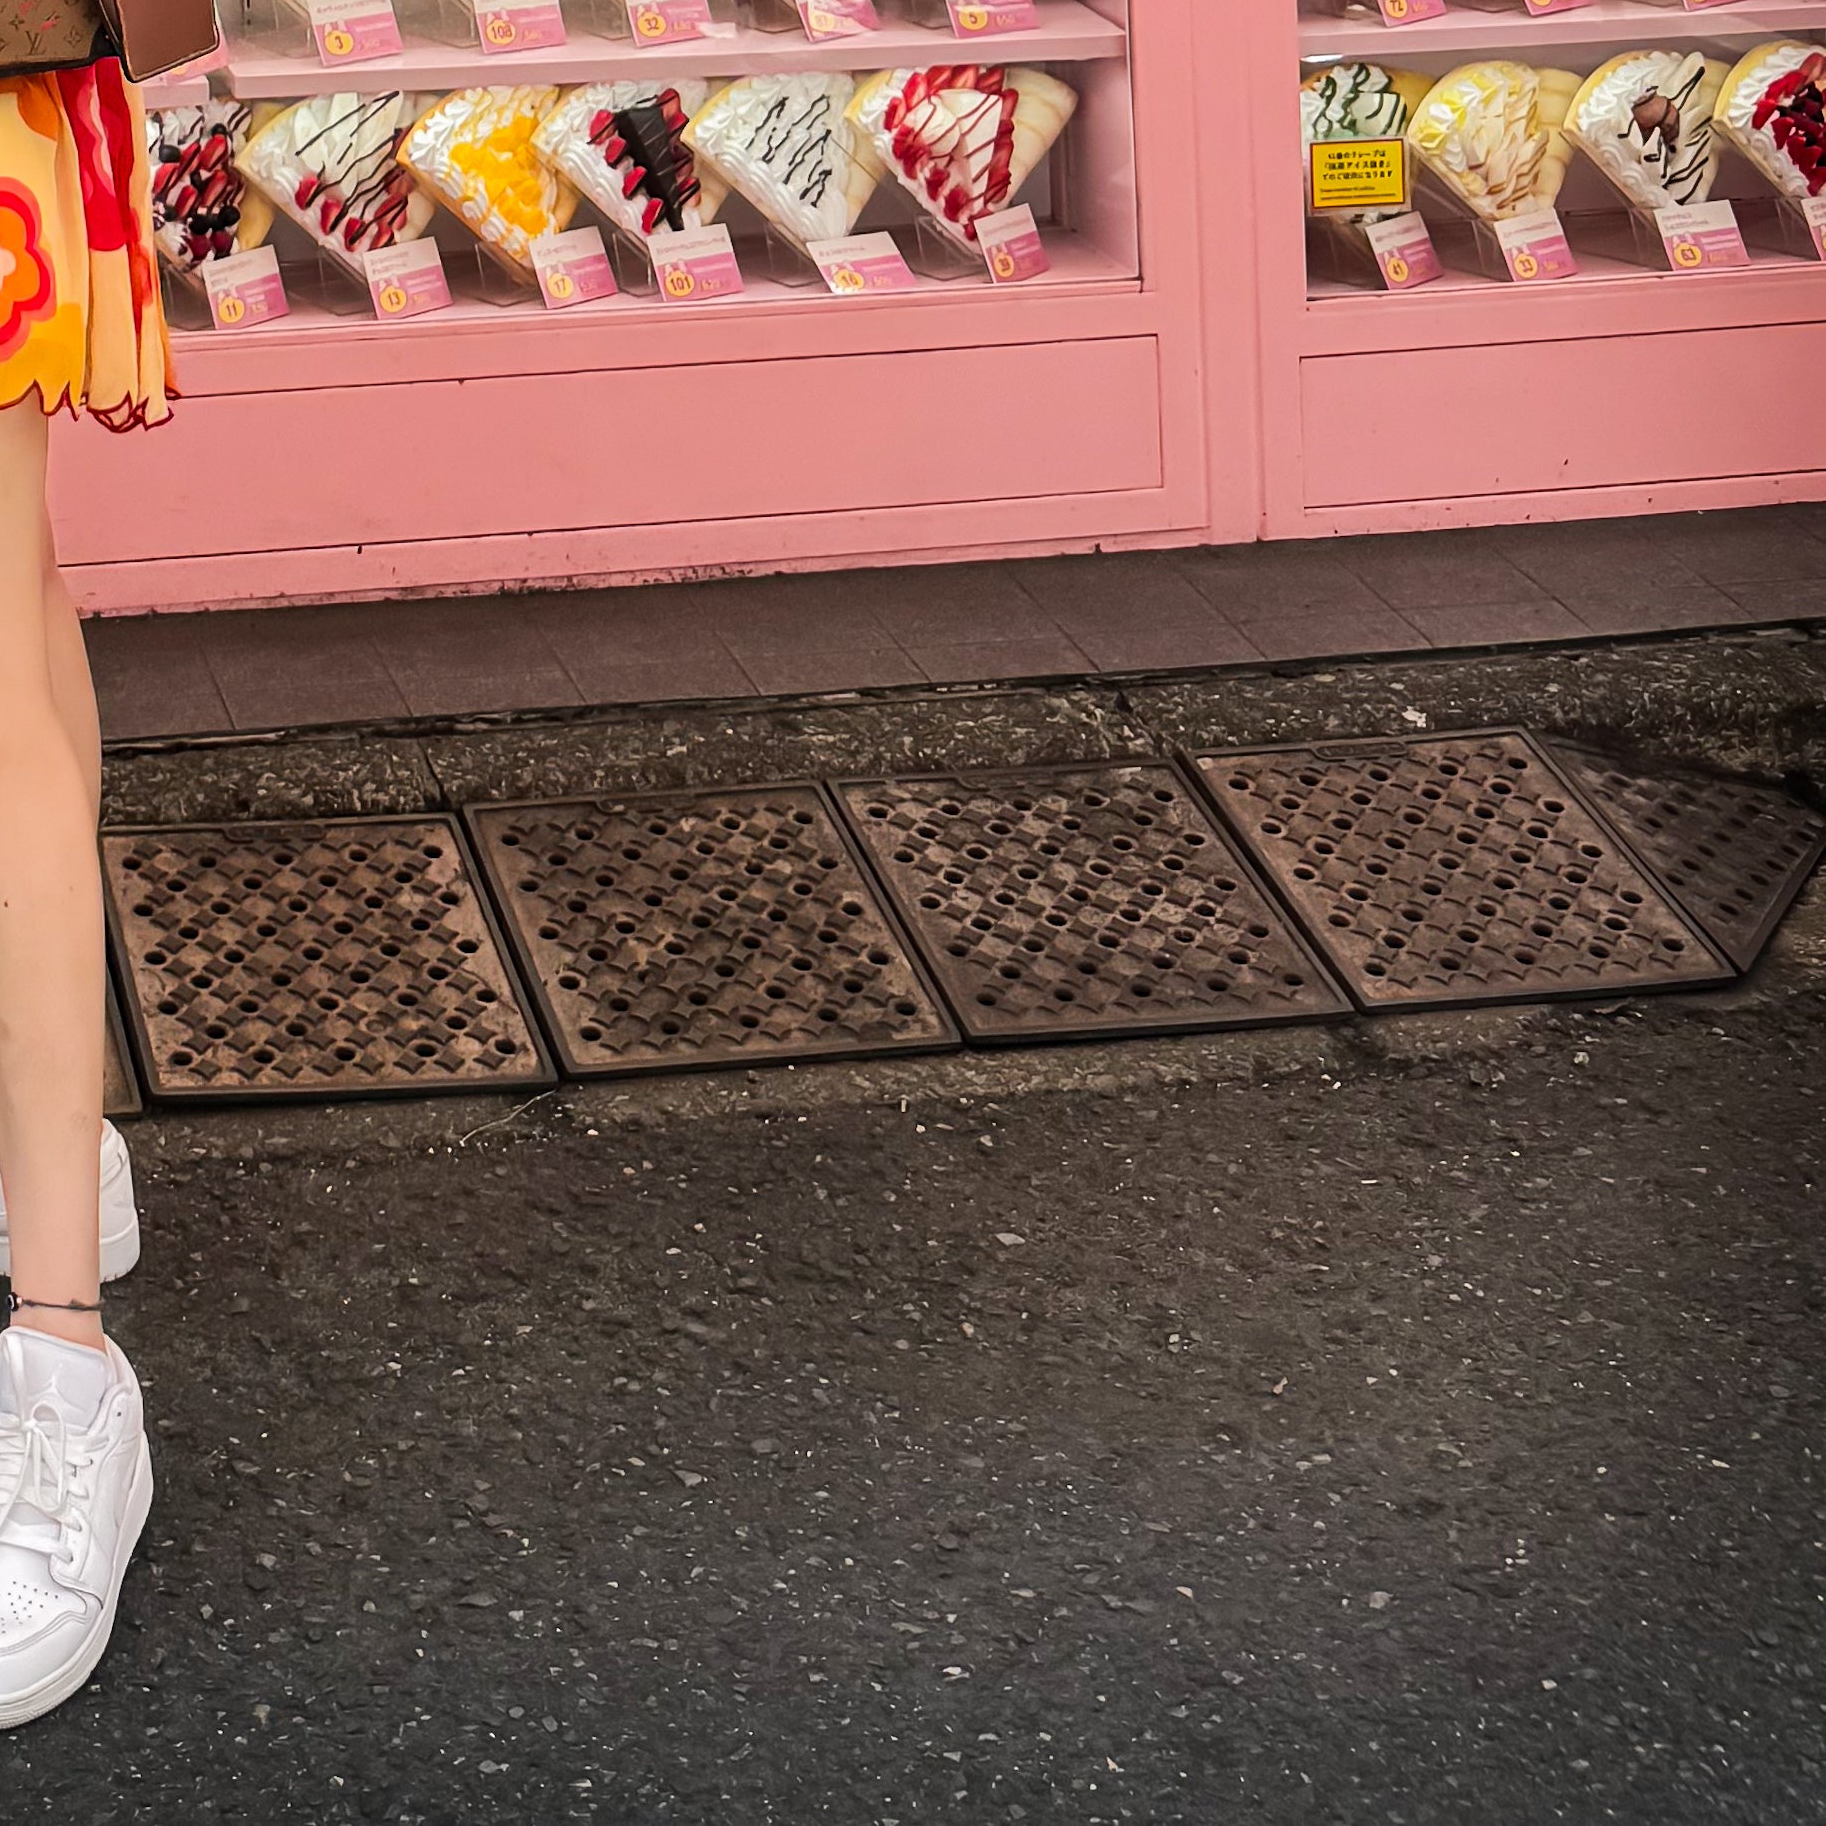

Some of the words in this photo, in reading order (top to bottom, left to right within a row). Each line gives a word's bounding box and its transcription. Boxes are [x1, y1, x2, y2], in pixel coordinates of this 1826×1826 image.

[644, 17, 660, 31] 32
[670, 275, 693, 291] 101
[225, 302, 238, 316] 11
